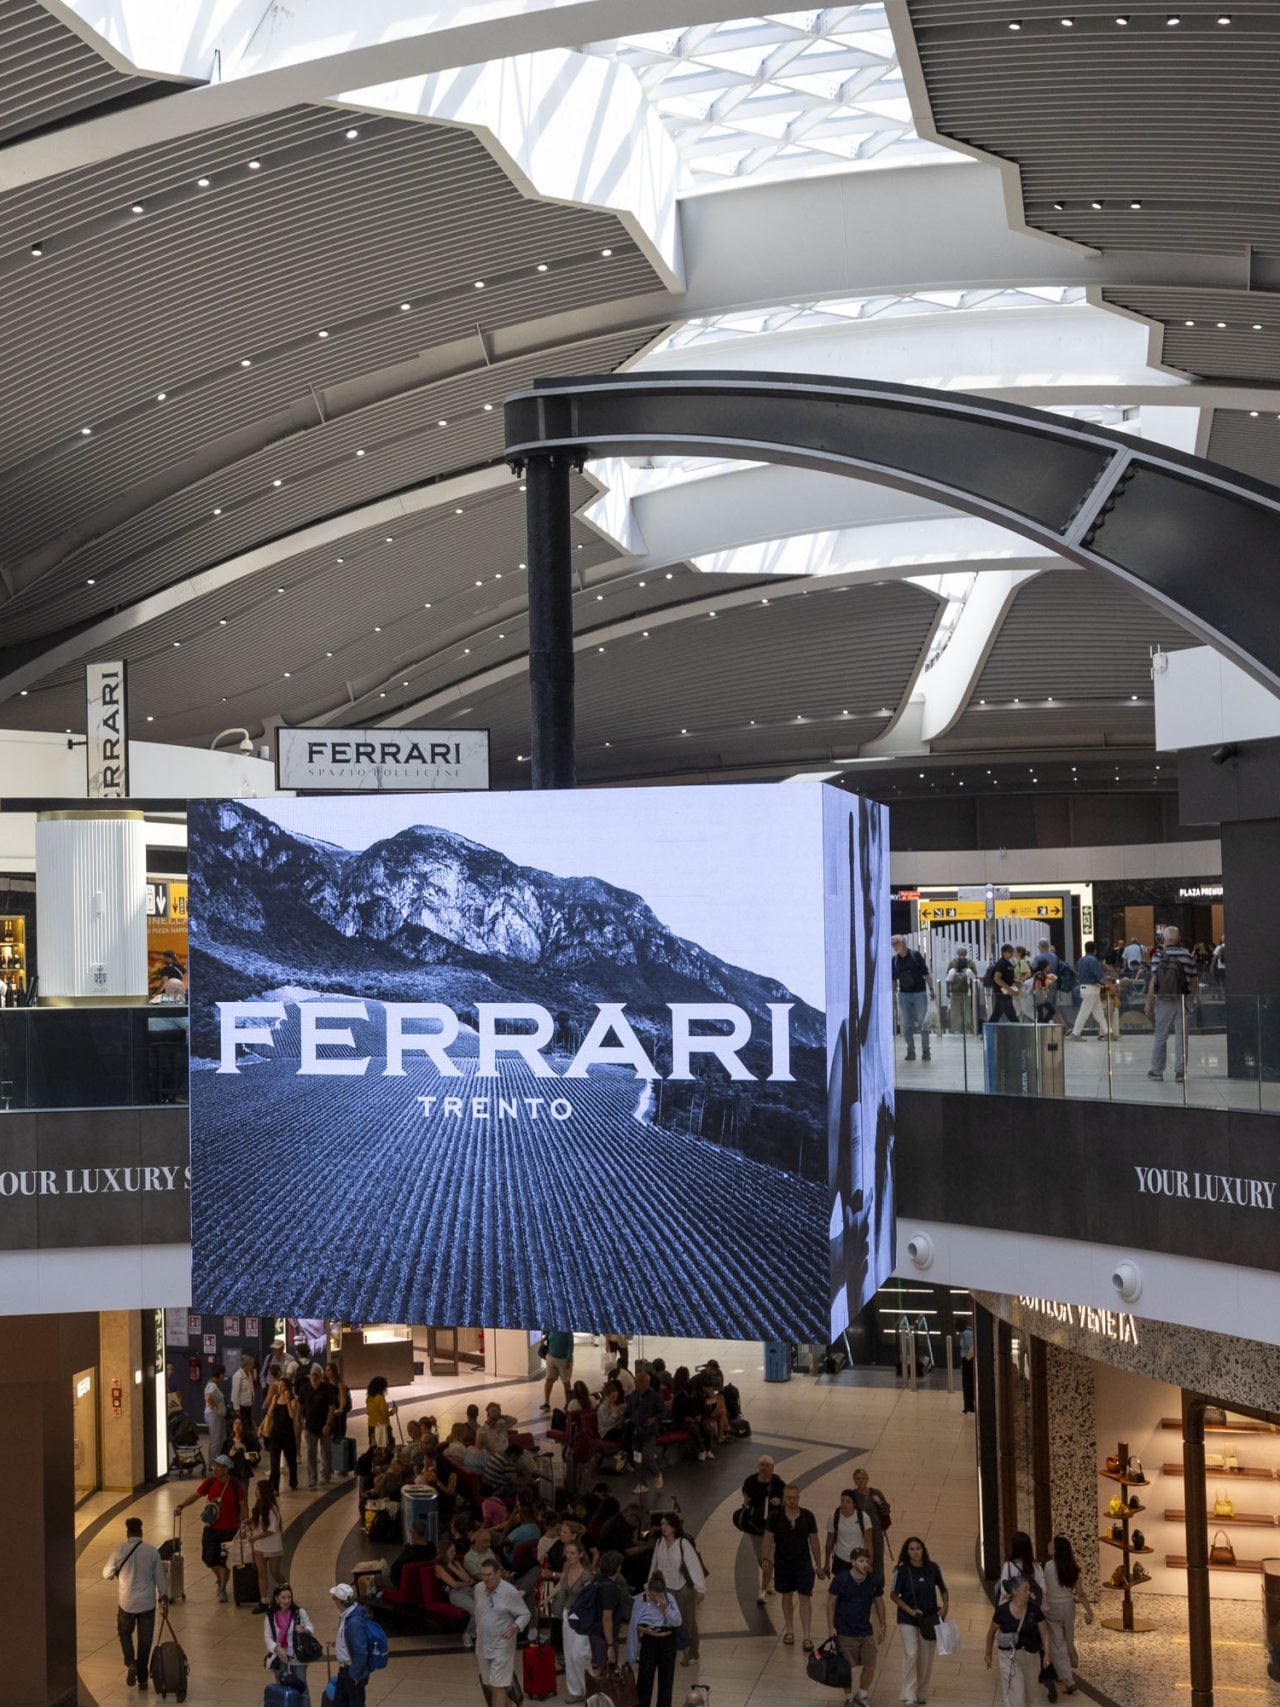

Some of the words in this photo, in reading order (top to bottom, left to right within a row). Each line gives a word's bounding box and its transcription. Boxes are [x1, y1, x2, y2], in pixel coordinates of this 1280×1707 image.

[102, 670, 121, 797] RRARI
[307, 742, 461, 764] FERRARI
[215, 1001, 798, 1082] FERRARI
[417, 1095, 574, 1121] TRENTO
[65, 1166, 181, 1194] LUXURY
[1134, 1166, 1190, 1198] YOUR
[1194, 1172, 1277, 1209] LUXURY
